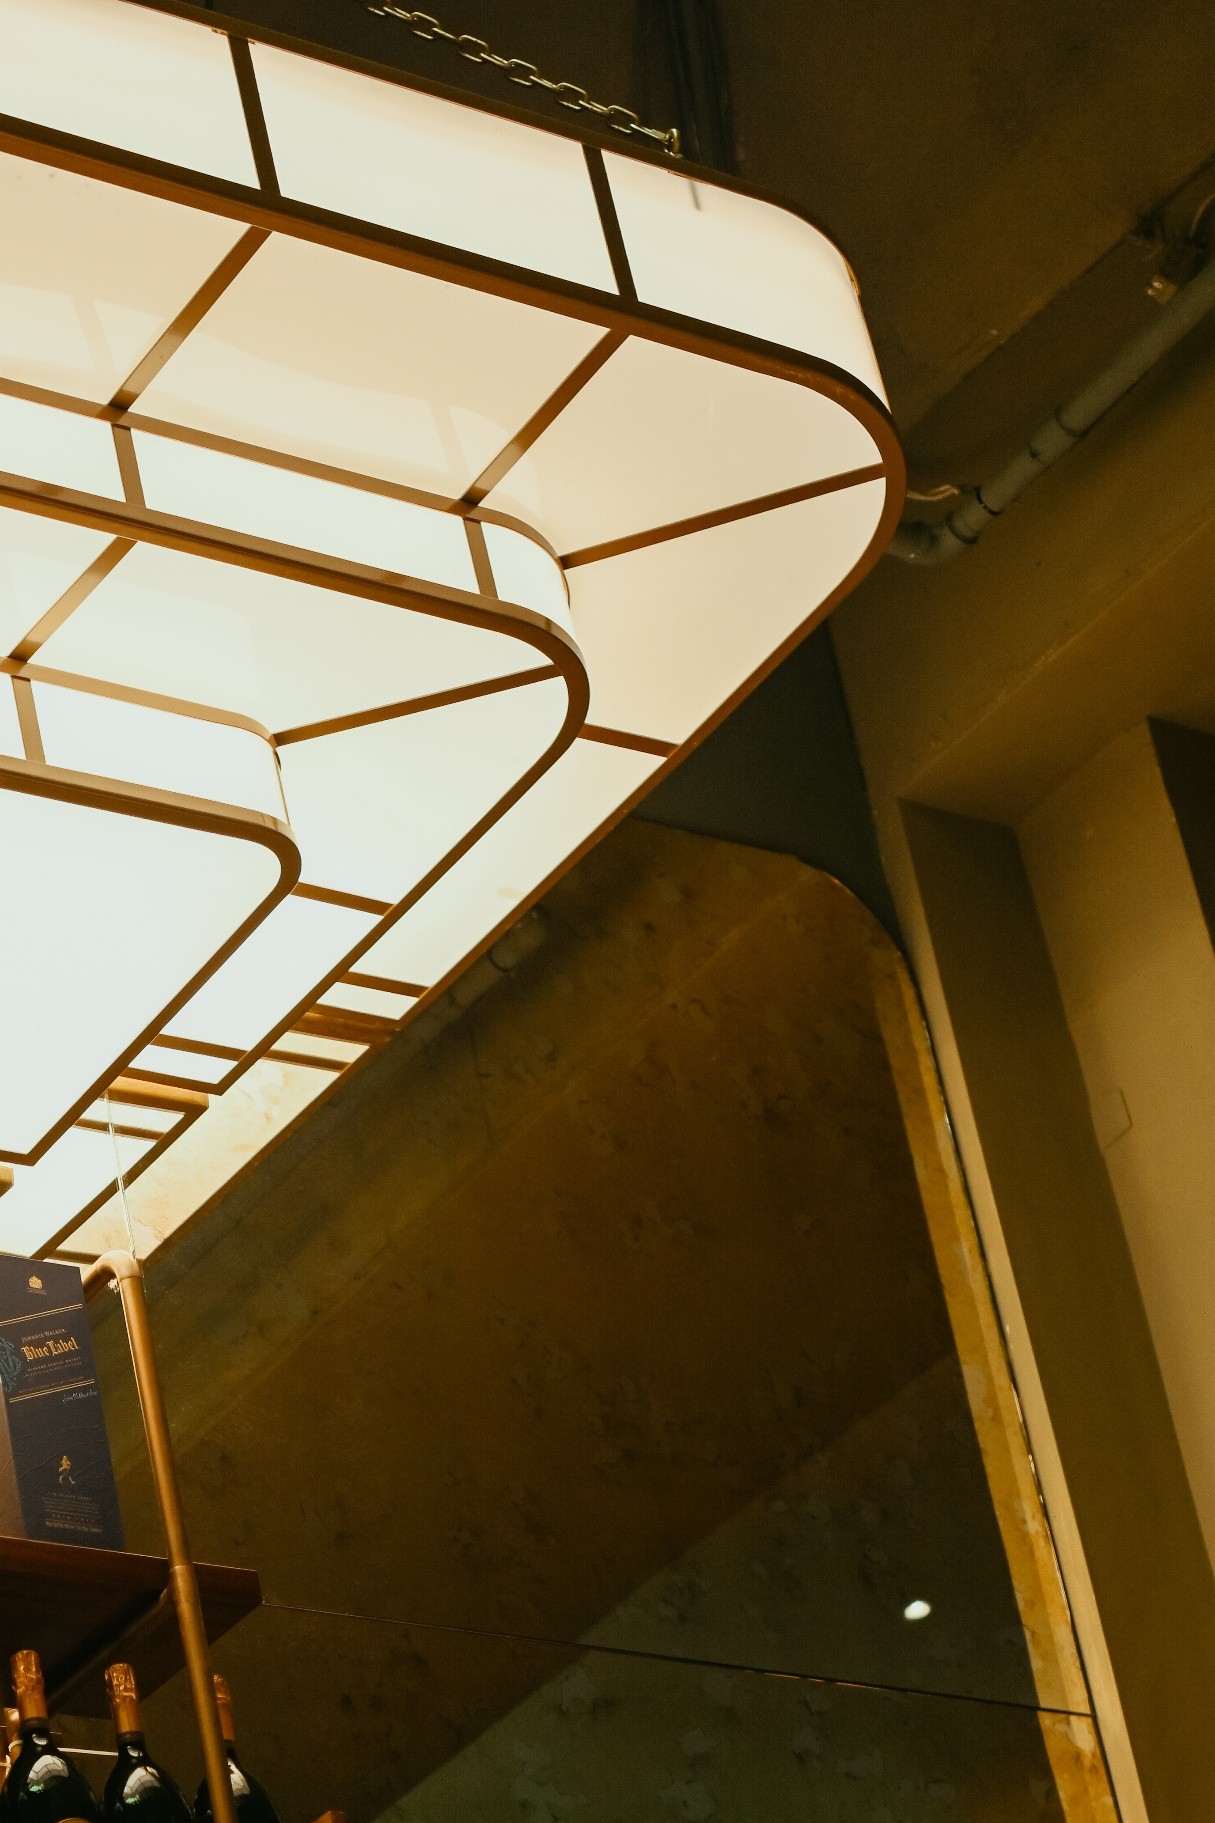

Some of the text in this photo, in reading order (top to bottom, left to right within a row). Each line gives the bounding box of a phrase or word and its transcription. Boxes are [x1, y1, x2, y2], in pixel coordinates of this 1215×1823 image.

[44, 1328, 67, 1338] WALKER
[21, 1337, 79, 1362] Blue Label
